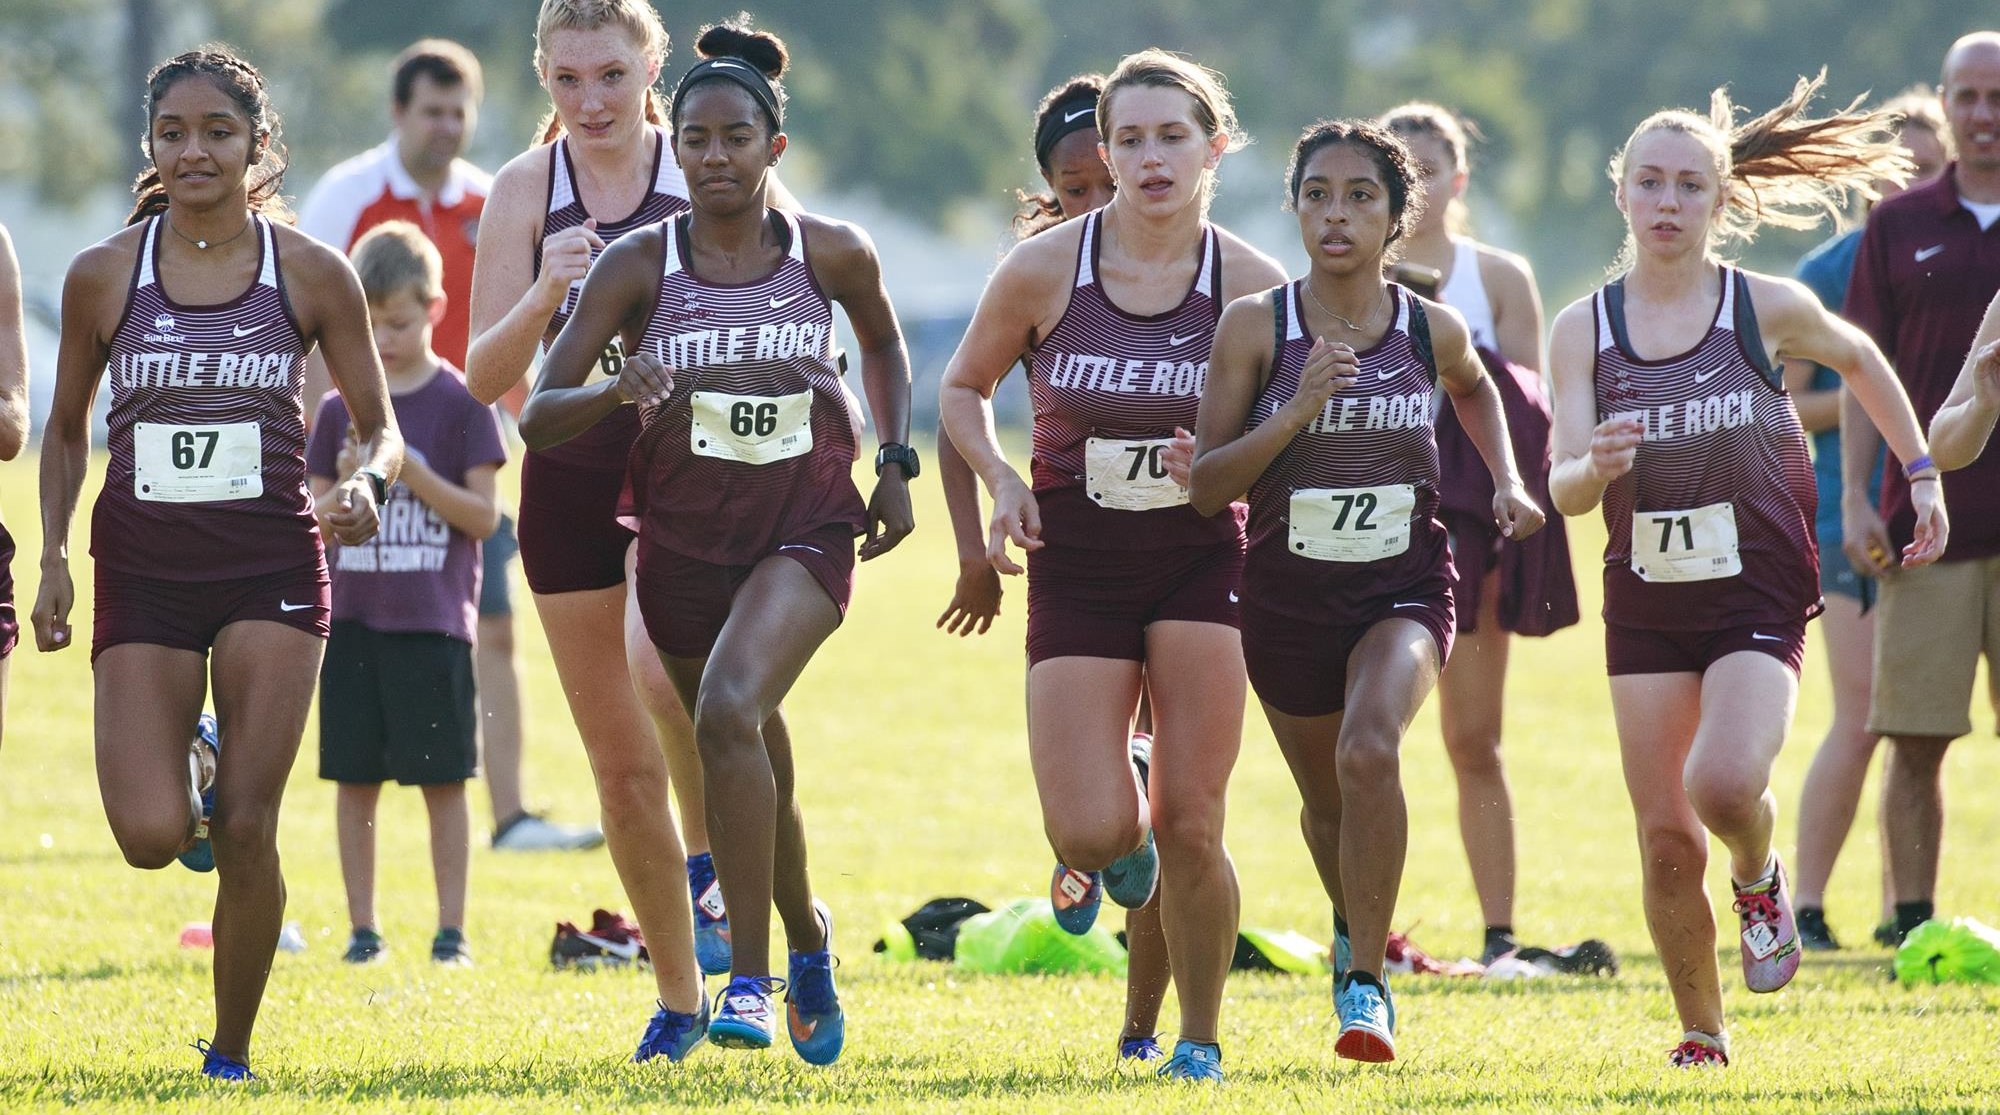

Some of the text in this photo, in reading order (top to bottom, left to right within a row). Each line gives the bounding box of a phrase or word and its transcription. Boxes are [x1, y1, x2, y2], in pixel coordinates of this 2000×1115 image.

[600, 341, 626, 377] 6
[755, 322, 826, 359] ROCK
[121, 353, 295, 389] LITTLE ROCK
[1050, 353, 1209, 398] LITTLE ROC
[730, 401, 778, 437] 66
[1365, 392, 1431, 430] ROCK
[1684, 390, 1754, 435] ROCK
[172, 431, 219, 470] 67
[1125, 445, 1169, 481] 70
[1332, 493, 1377, 531] 72
[1652, 516, 1694, 553] 71
